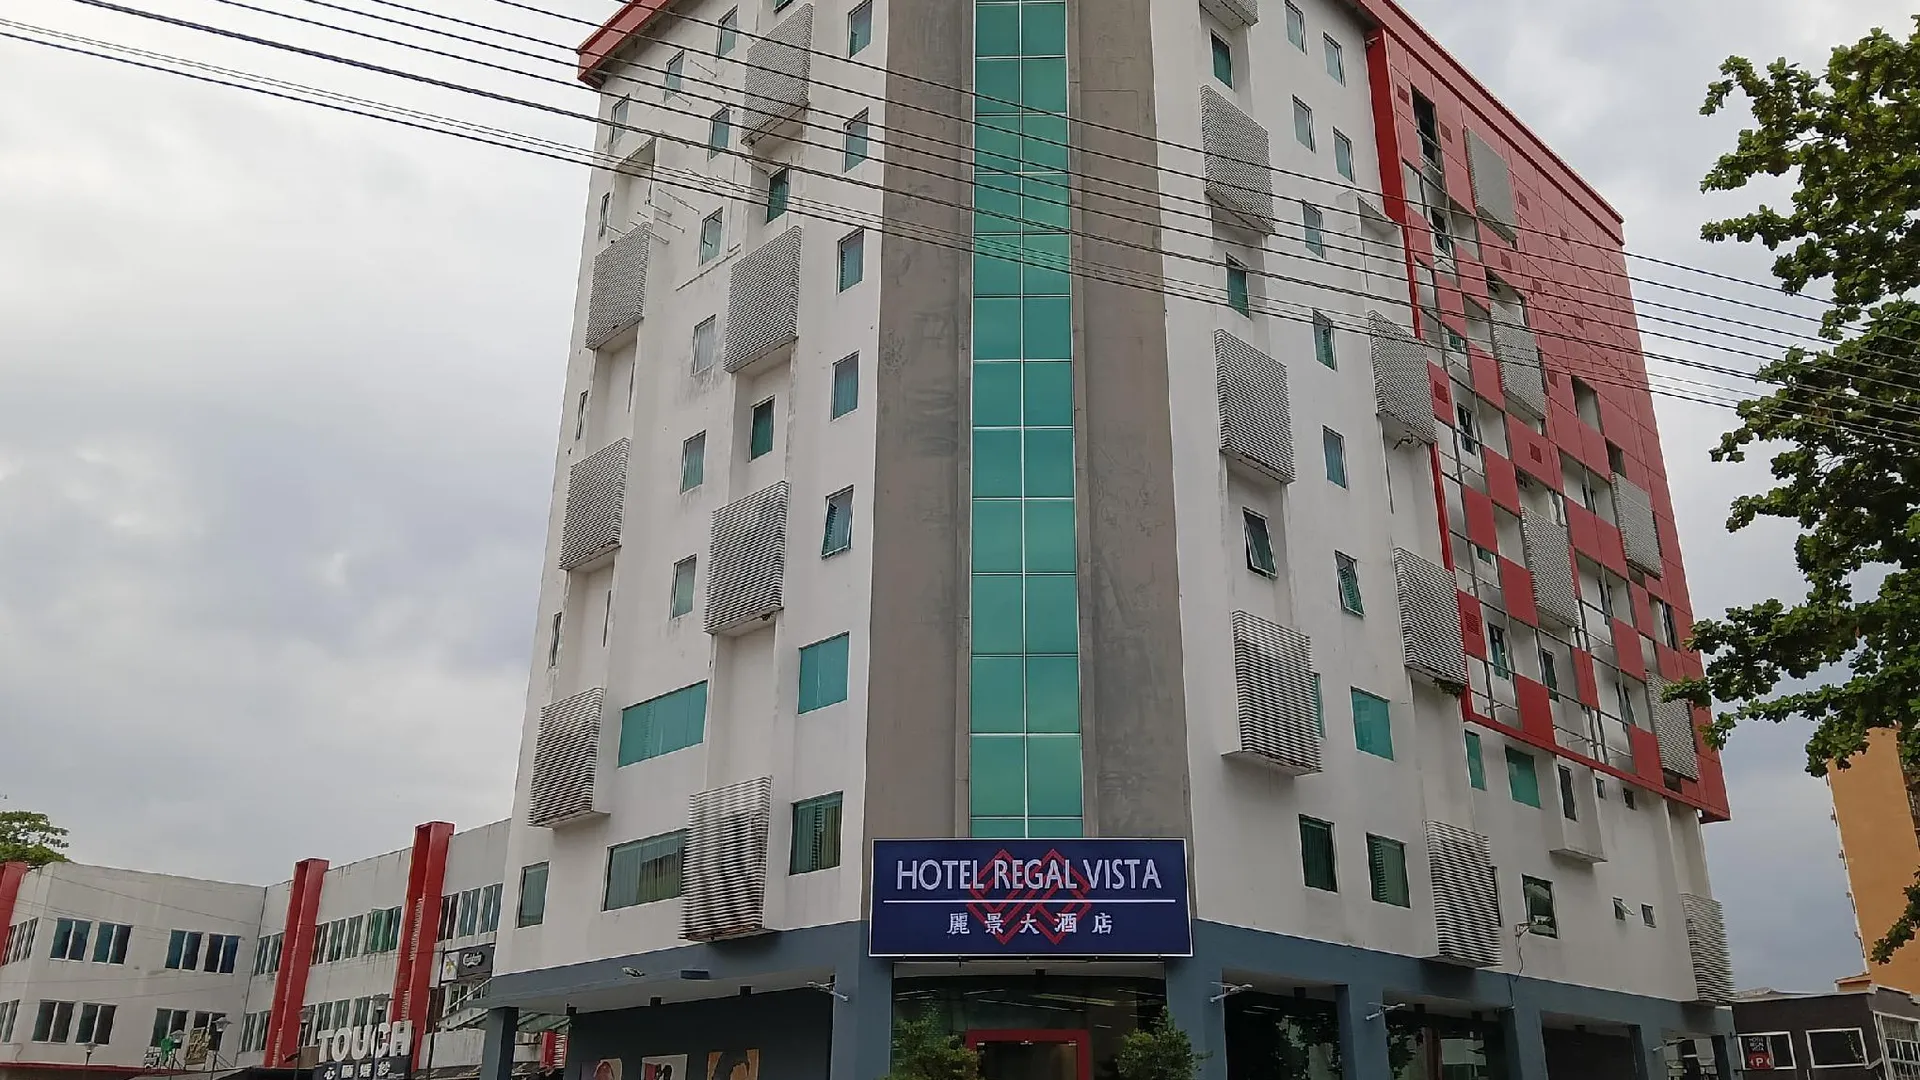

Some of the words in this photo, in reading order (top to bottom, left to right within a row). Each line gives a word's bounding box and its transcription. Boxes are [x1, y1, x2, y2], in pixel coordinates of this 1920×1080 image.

[897, 859, 984, 890] HOTEL
[994, 858, 1077, 890] REGAL
[1082, 859, 1162, 889] VISTA
[947, 912, 1113, 935] 麗景大酒店
[317, 1020, 413, 1063] TOUCH
